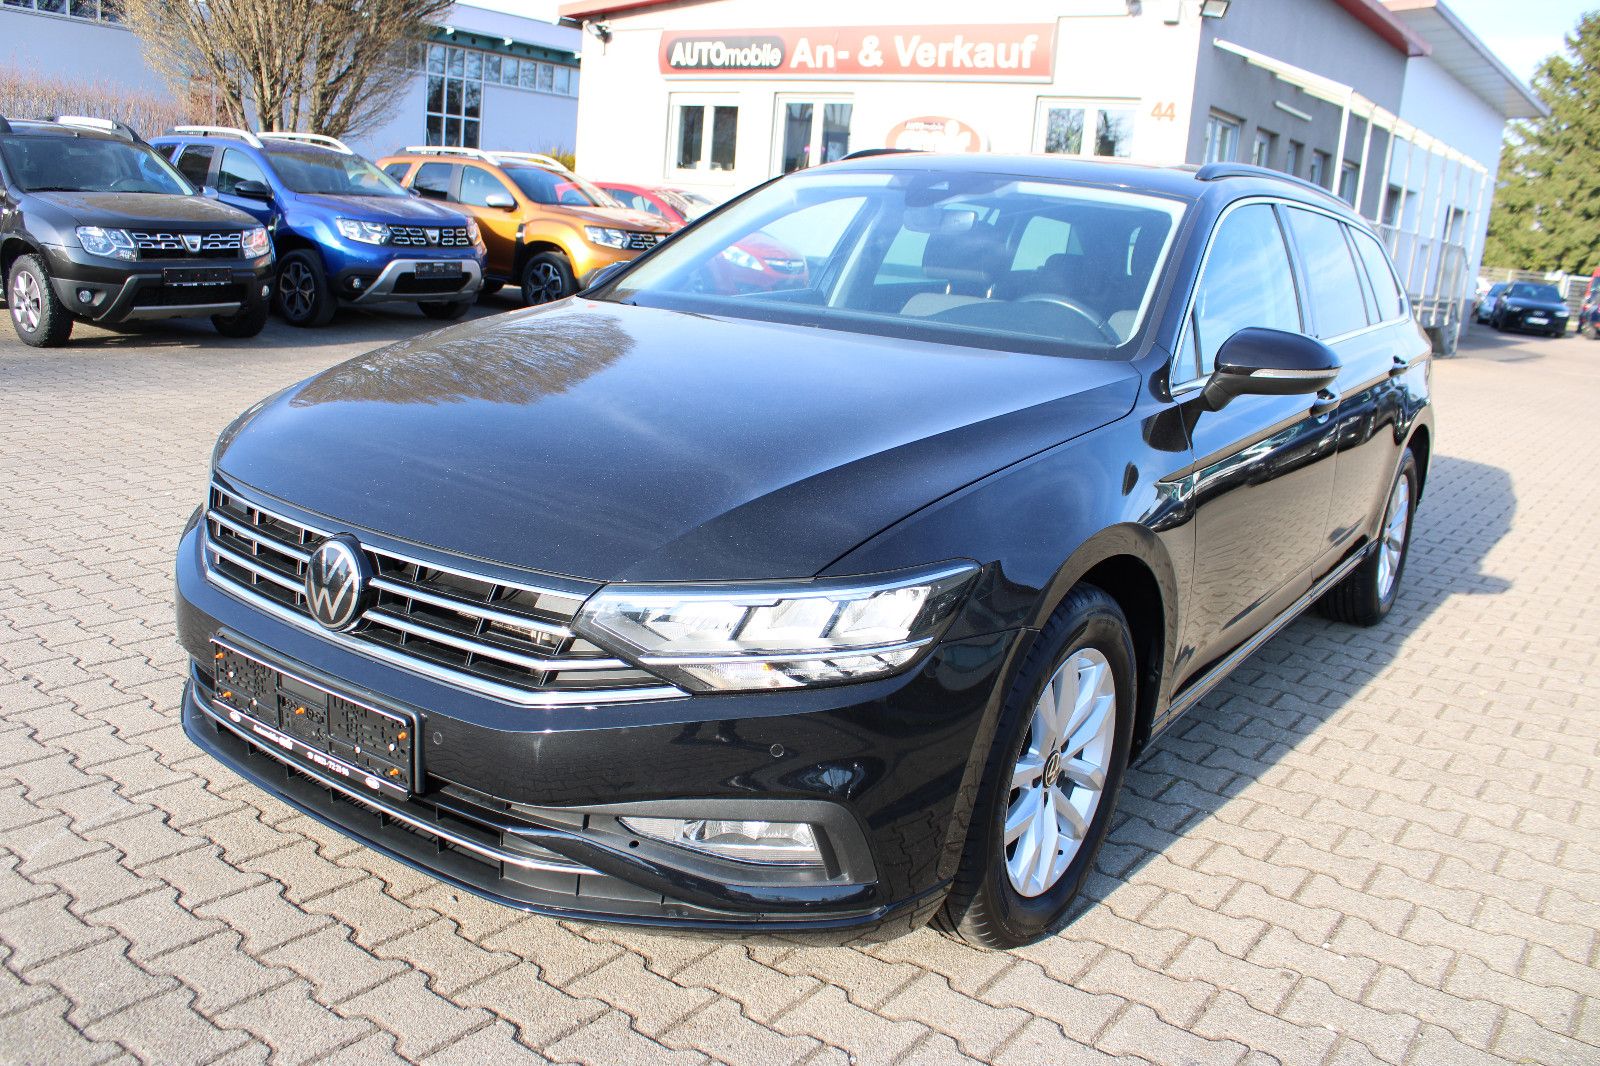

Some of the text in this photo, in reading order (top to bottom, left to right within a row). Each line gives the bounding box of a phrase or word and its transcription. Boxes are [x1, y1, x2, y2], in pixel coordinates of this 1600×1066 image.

[670, 34, 1040, 69] AUTOmobile An- & Verkauf
[1151, 101, 1176, 121] 44
